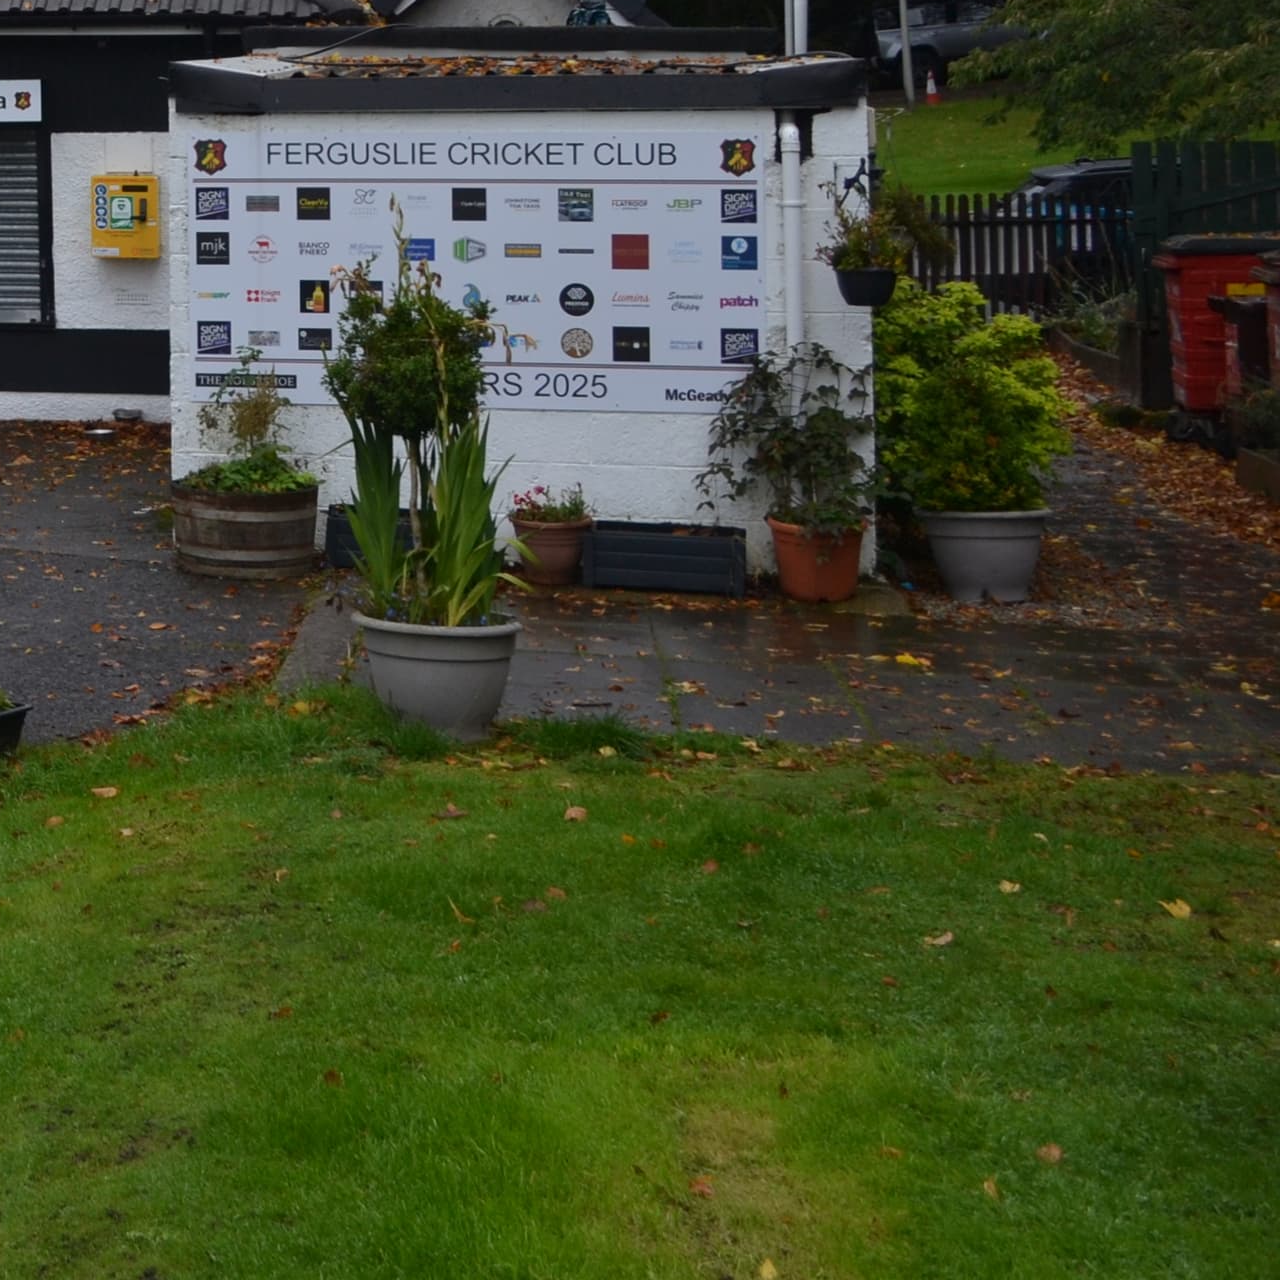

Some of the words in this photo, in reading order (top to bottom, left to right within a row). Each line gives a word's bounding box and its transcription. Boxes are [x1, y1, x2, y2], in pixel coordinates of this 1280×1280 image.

[267, 142, 437, 166] FERGUSLIE
[447, 141, 584, 166] CRICKET
[594, 142, 677, 167] CLUB
[198, 191, 222, 200] SIGN
[724, 192, 749, 203] SIGN
[666, 199, 703, 209] JBP
[200, 237, 226, 254] mjk
[506, 294, 530, 303] PEAK
[720, 295, 758, 309] patch
[200, 324, 224, 335] SIGN
[724, 333, 749, 344] SIGN
[198, 375, 222, 385] THE
[534, 373, 608, 399] 2025
[665, 388, 730, 405] McGeady
